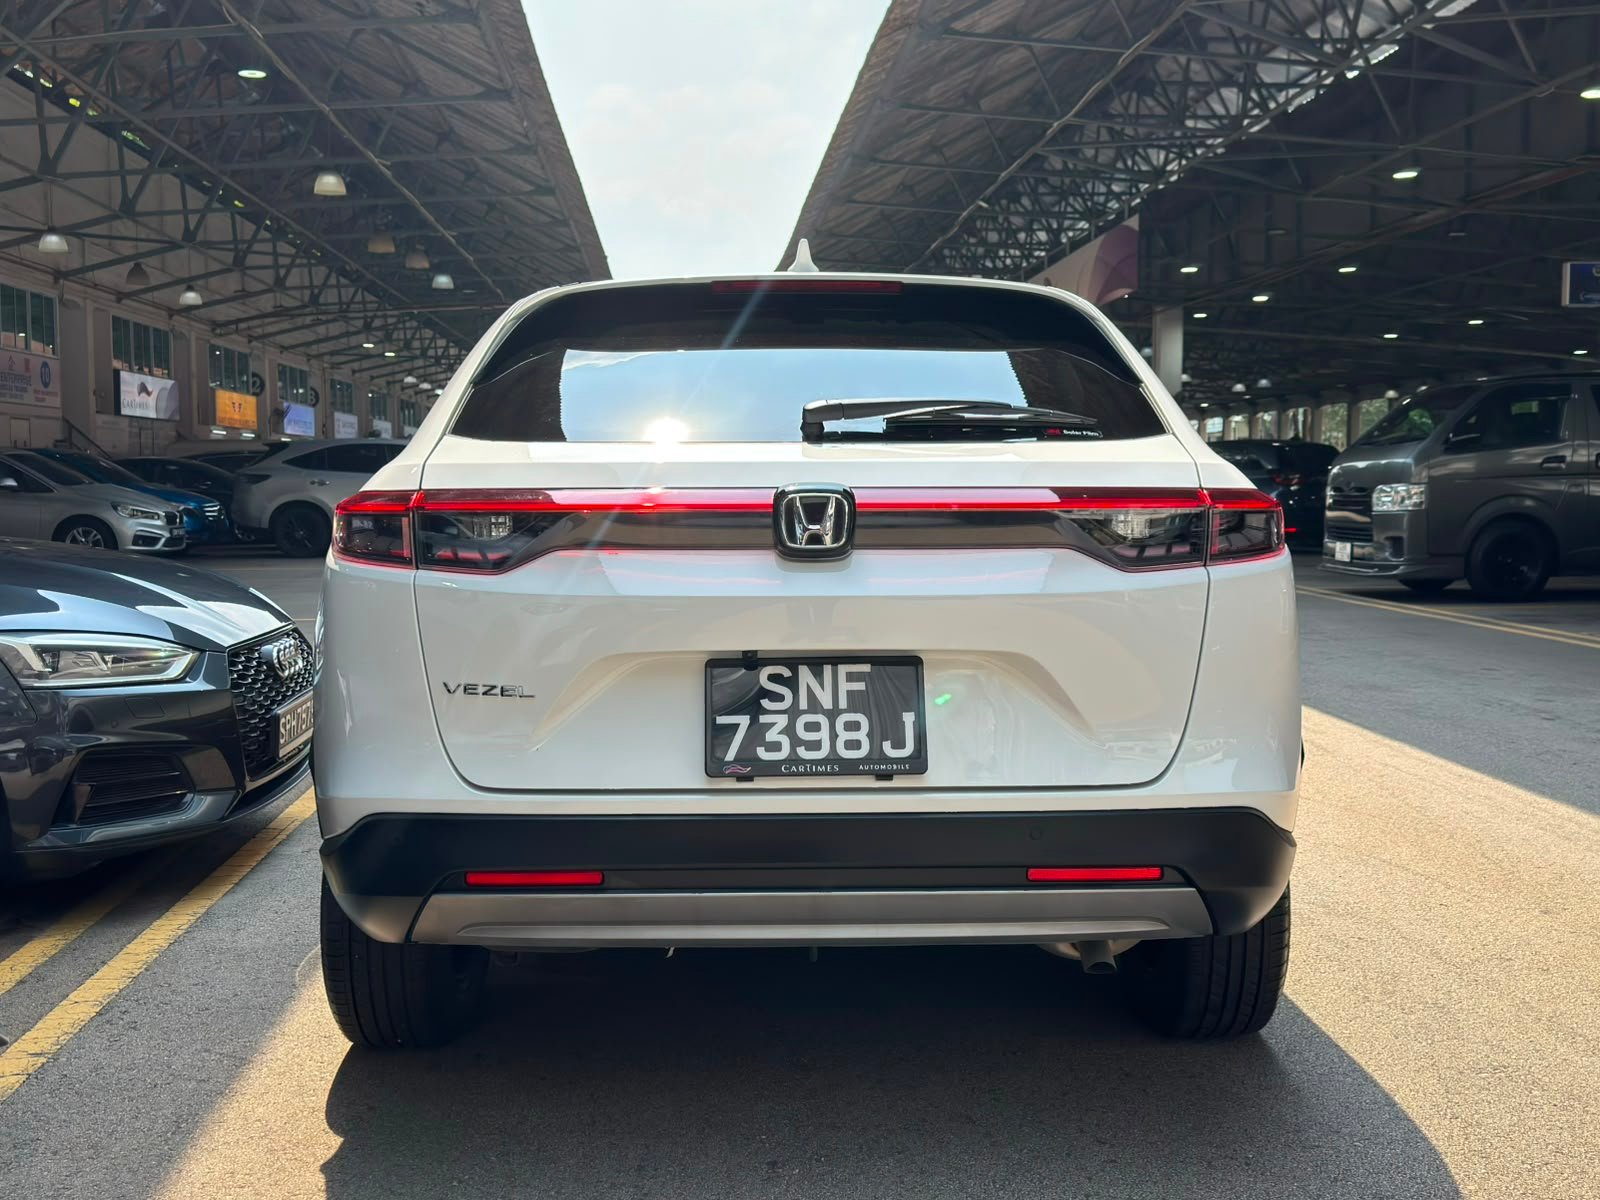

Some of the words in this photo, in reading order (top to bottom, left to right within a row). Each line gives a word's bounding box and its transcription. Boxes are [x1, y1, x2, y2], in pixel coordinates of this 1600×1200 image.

[443, 681, 536, 698] VEZEL
[759, 664, 871, 710] SNF
[280, 699, 314, 745] SPH757
[715, 713, 870, 761] 7398
[882, 711, 916, 758] J
